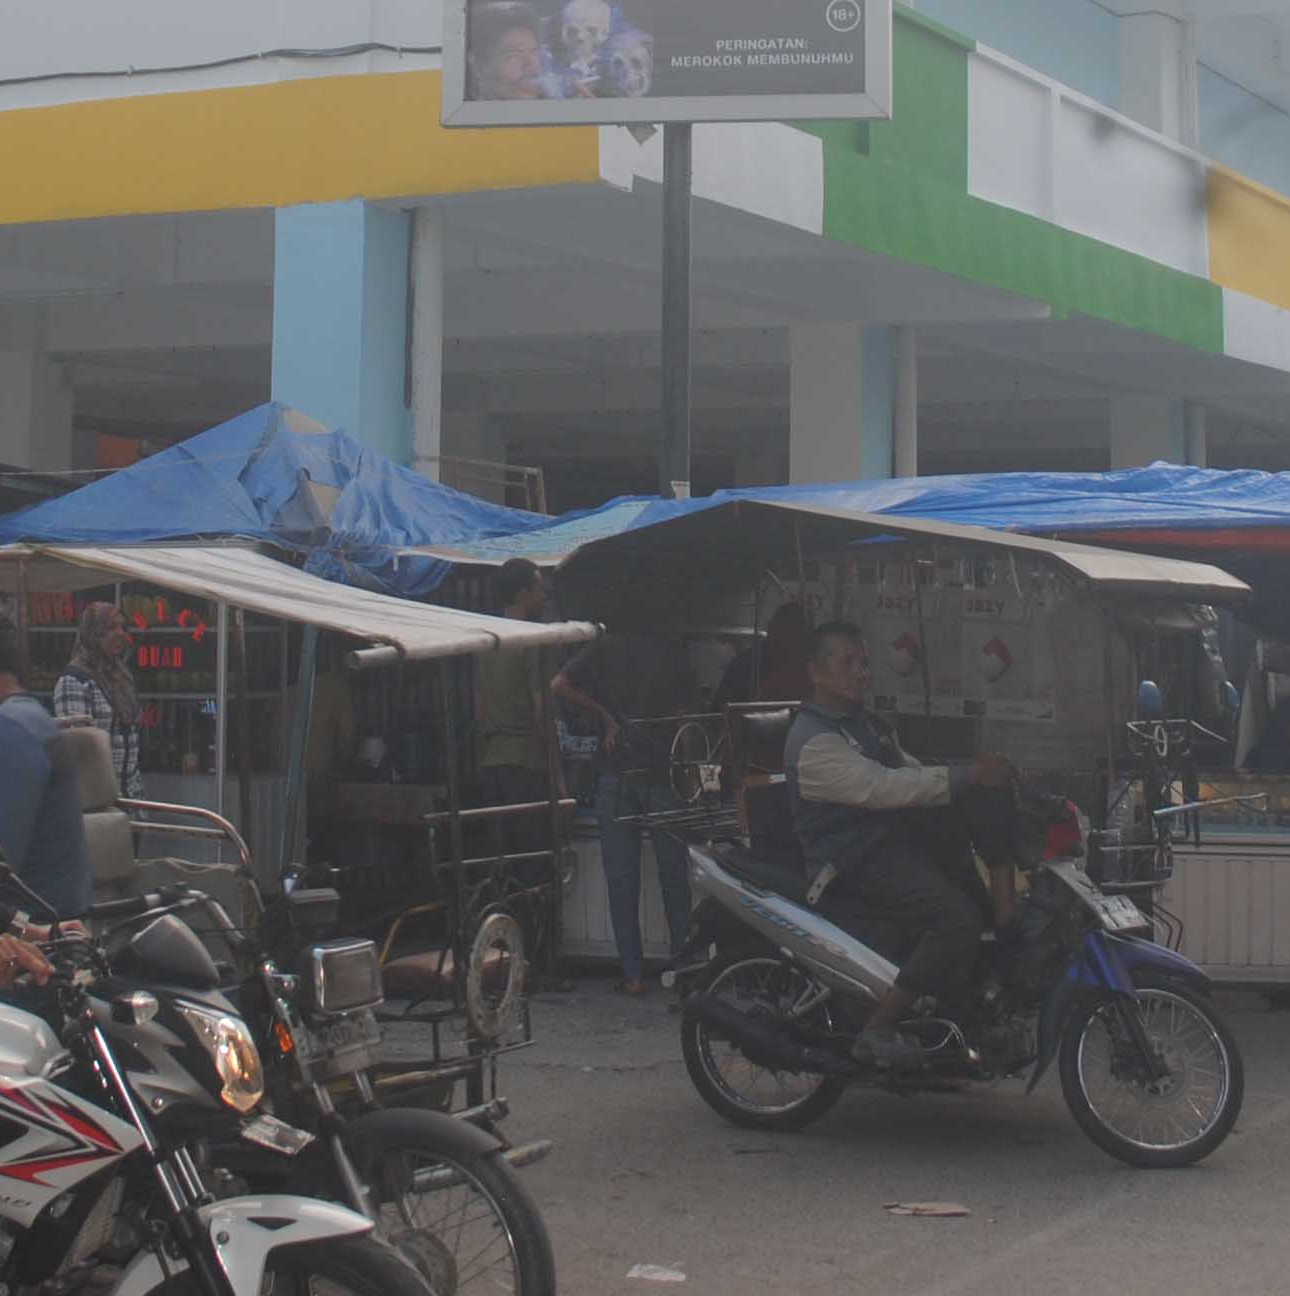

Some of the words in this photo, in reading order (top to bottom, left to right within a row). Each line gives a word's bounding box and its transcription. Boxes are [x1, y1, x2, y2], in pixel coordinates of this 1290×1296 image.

[831, 7, 856, 22] 18+
[670, 54, 742, 68] MEROKOK
[746, 52, 855, 67] MEMBUNUHMU
